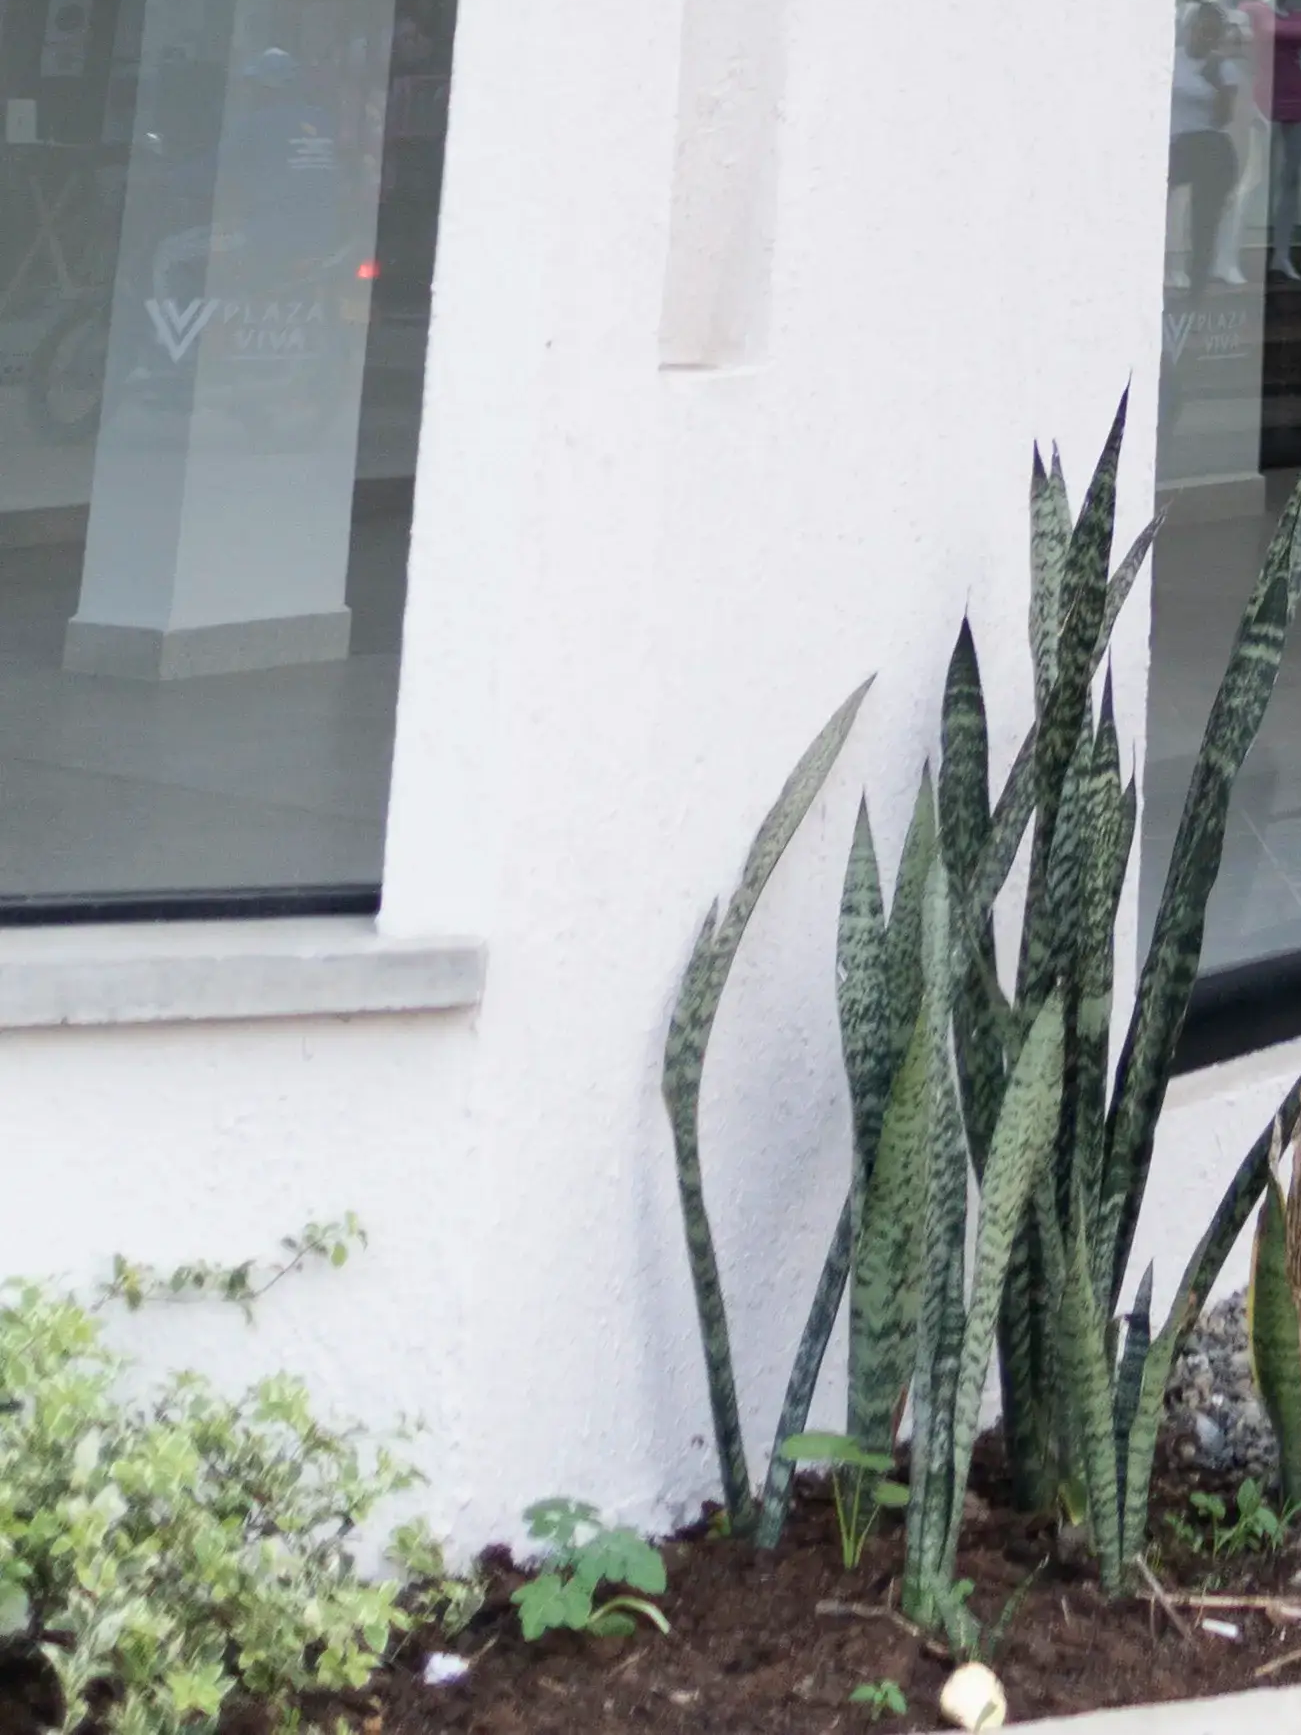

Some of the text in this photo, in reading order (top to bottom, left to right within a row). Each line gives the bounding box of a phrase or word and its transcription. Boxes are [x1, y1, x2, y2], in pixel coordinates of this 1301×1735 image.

[223, 300, 324, 325] PLAZA
[1198, 309, 1247, 332] PLAZA
[235, 327, 307, 350] VIVA
